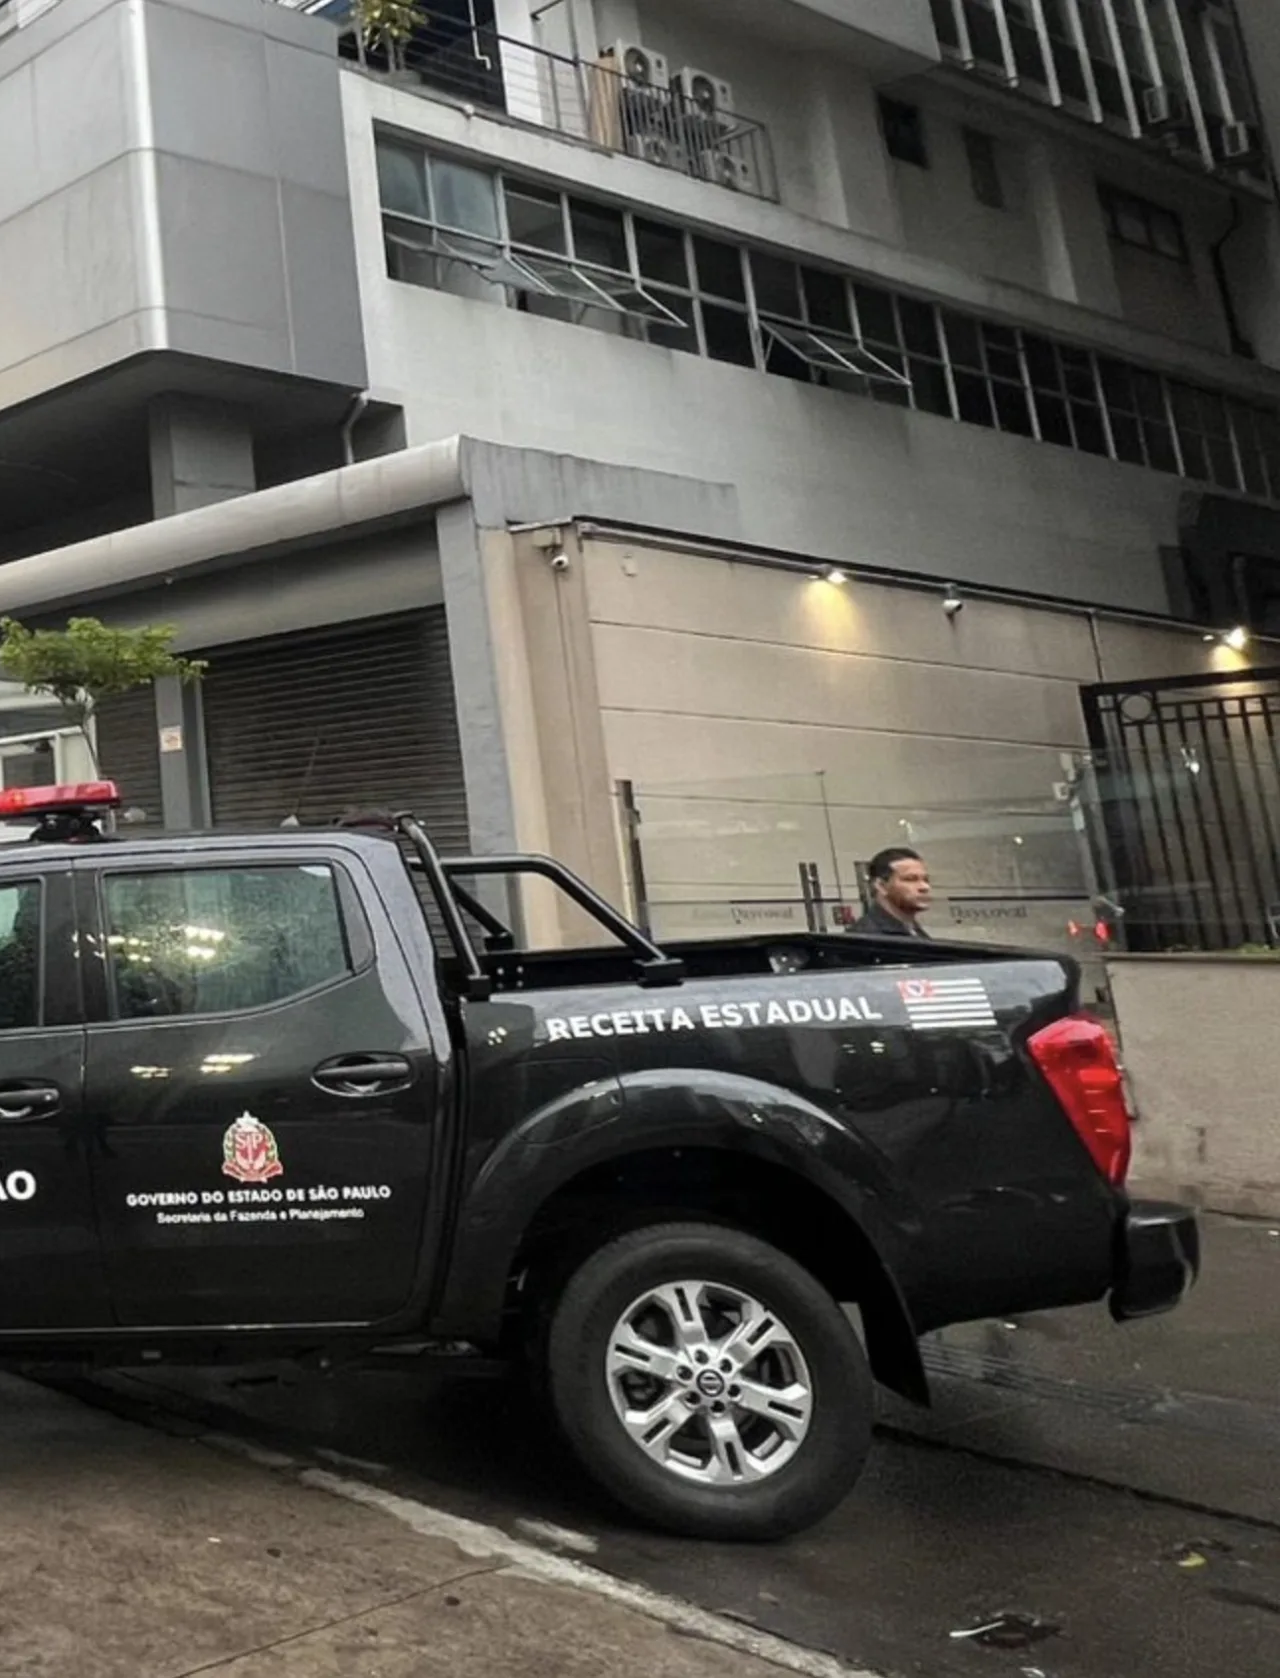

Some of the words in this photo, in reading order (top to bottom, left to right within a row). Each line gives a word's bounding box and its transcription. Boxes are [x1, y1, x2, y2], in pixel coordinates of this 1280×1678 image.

[544, 1005, 695, 1042] RECEITA
[701, 996, 883, 1028] ESTADUAL
[126, 1191, 198, 1206] GOVERNO
[202, 1189, 224, 1204] DO
[228, 1187, 283, 1203] ESTADO
[286, 1187, 305, 1201] DE
[308, 1184, 339, 1200] SÃO
[343, 1185, 391, 1199] PAULO
[156, 1210, 211, 1224] Secretaria
[214, 1209, 228, 1222] da
[230, 1208, 277, 1221] Fazenda
[280, 1210, 287, 1220] e
[289, 1206, 365, 1222] Planejamento
